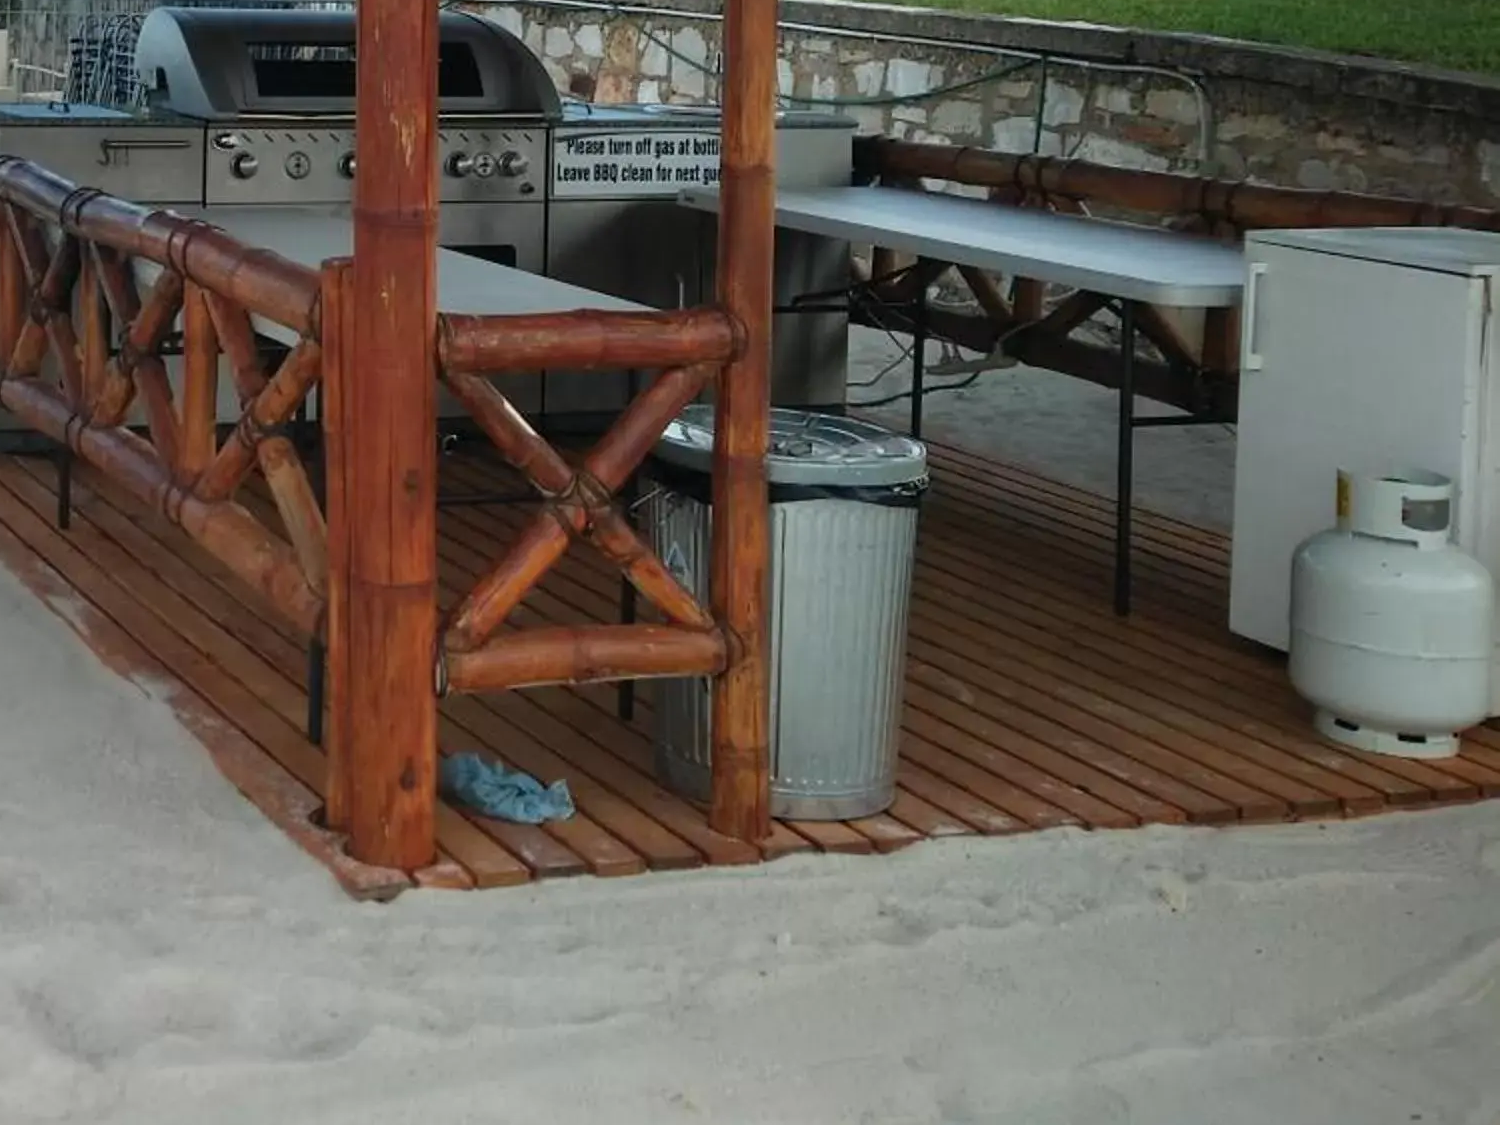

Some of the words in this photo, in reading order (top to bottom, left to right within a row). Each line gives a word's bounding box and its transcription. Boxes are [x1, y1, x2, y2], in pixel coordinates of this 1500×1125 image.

[566, 137, 605, 156] Please
[608, 138, 633, 156] turn
[635, 137, 652, 156] off
[655, 140, 675, 159] gas
[677, 138, 690, 156] at
[693, 137, 720, 156] bottl
[557, 163, 591, 181] Leave
[593, 163, 618, 183] BBQ
[621, 164, 653, 181] clean
[656, 163, 673, 181] for
[675, 164, 700, 181] next
